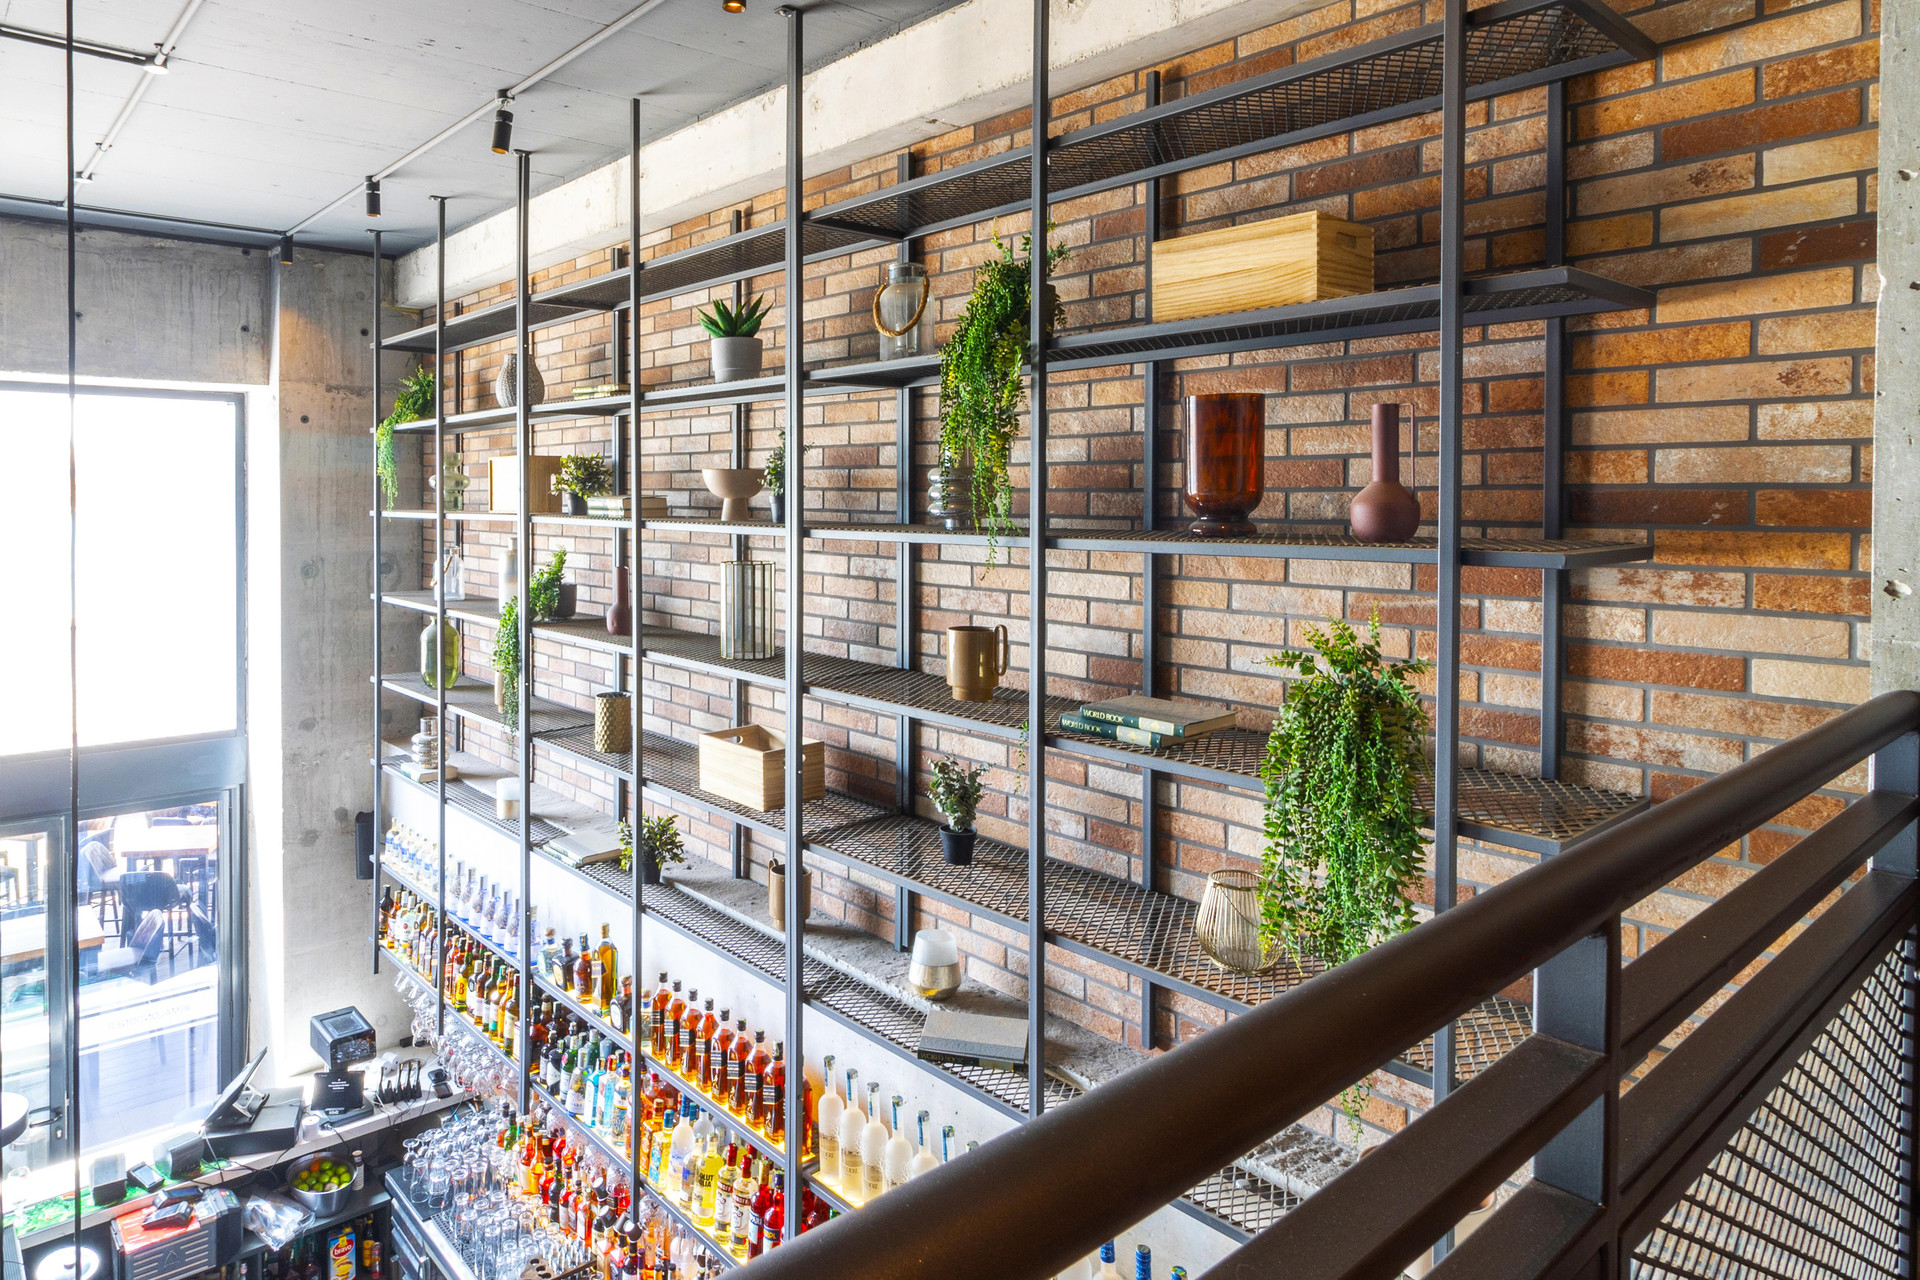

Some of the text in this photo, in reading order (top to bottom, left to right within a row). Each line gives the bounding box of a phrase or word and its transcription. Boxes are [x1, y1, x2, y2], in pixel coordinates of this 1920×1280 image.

[1083, 709, 1124, 724] WORLD BOOK
[1062, 718, 1102, 733] WORLD BOOK
[334, 1244, 352, 1256] bravo
